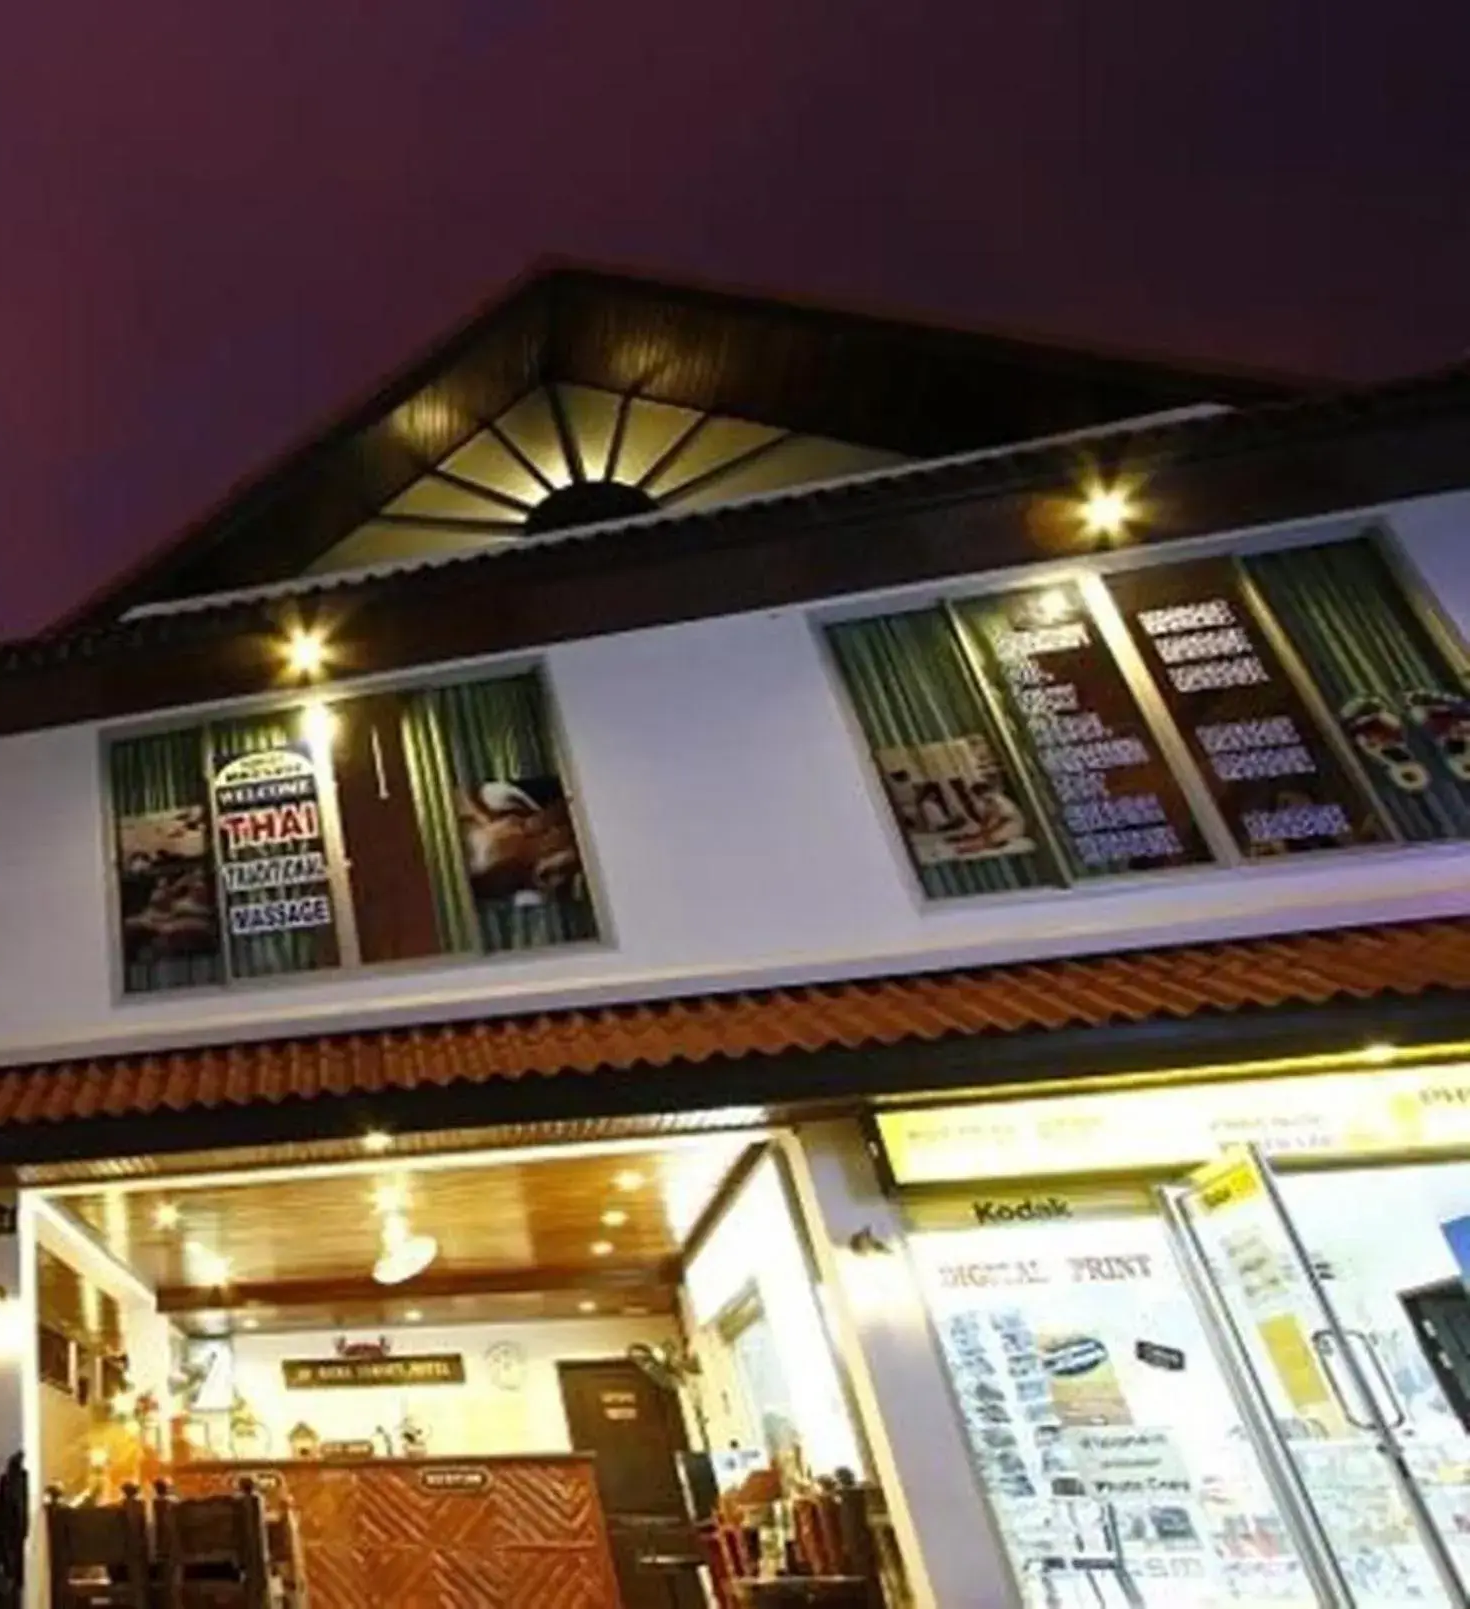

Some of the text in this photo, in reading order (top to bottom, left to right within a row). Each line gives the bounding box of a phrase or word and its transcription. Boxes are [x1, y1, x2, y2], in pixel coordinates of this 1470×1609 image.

[219, 778, 311, 804] WELCOME
[221, 802, 318, 849] THAI
[232, 898, 327, 933] MASSAGE
[973, 1197, 1072, 1225] Kodak
[1066, 1252, 1152, 1283] PRINT
